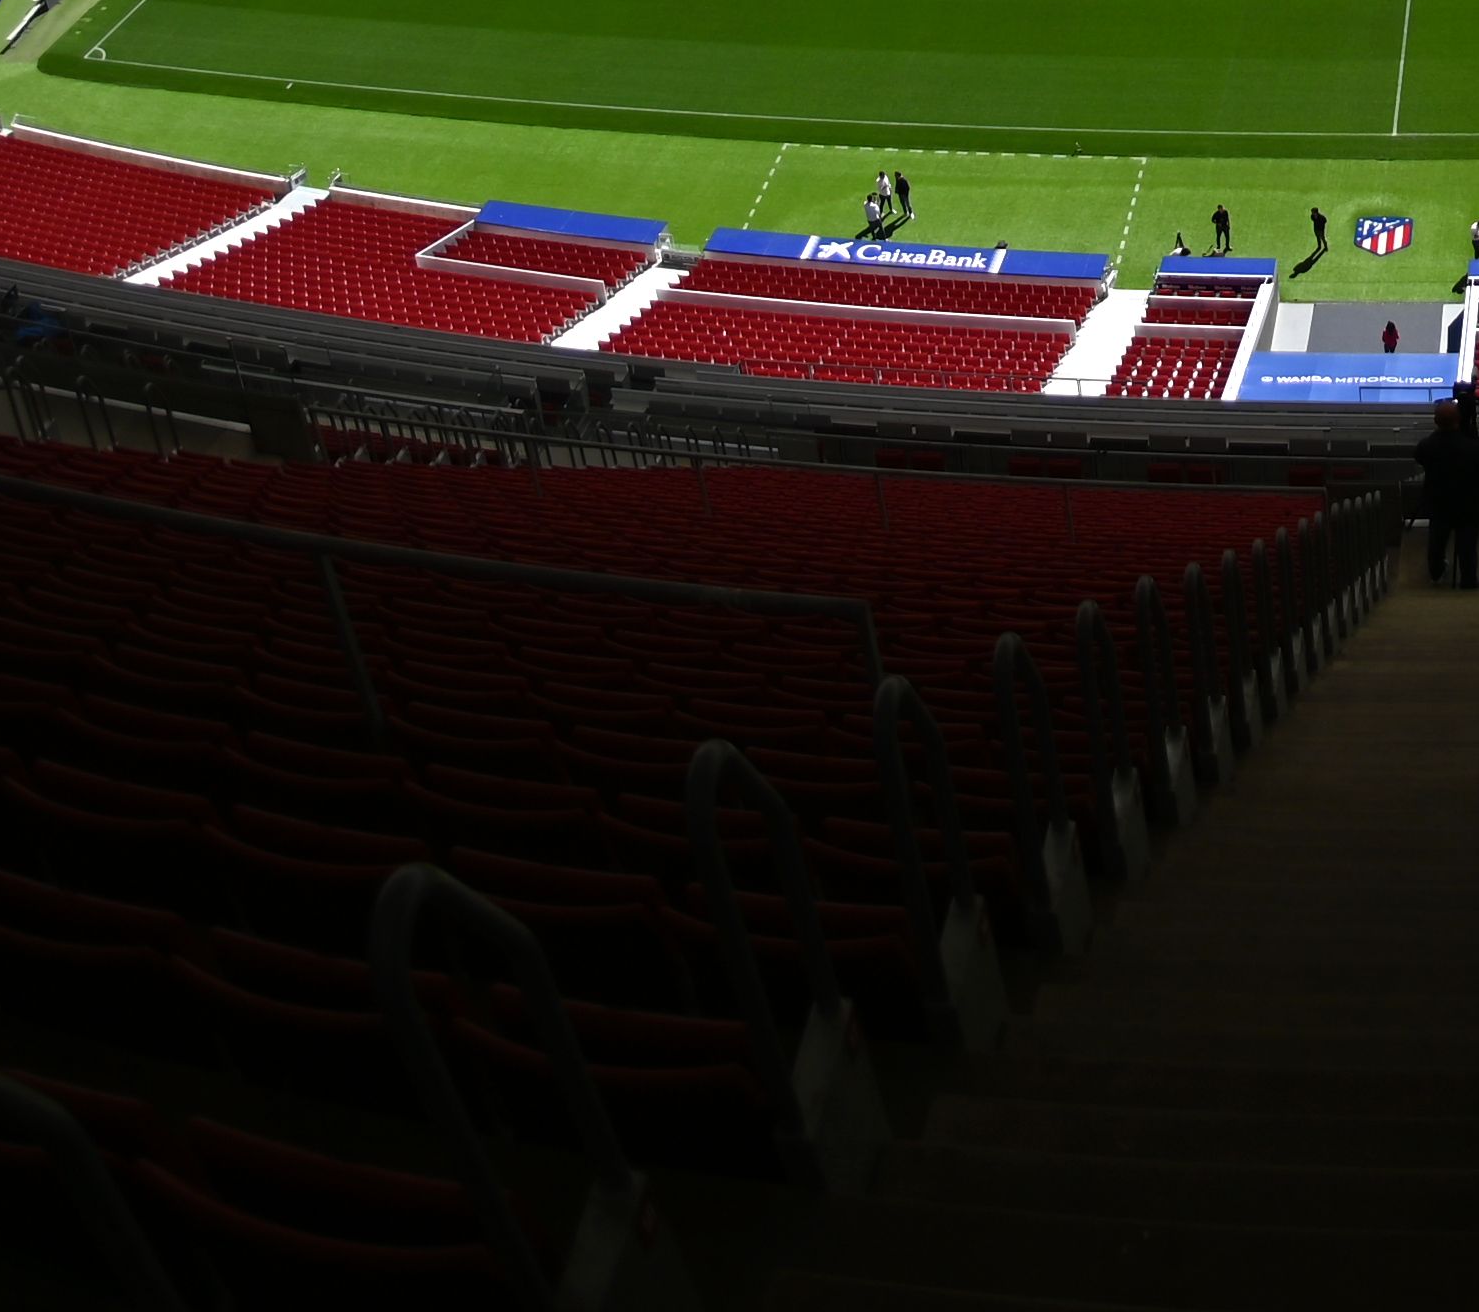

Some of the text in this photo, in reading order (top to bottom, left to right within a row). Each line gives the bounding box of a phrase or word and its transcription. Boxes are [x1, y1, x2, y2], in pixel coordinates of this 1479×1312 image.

[856, 243, 988, 269] CaixaBank
[1276, 375, 1444, 384] WANDA METROPOLITANO
